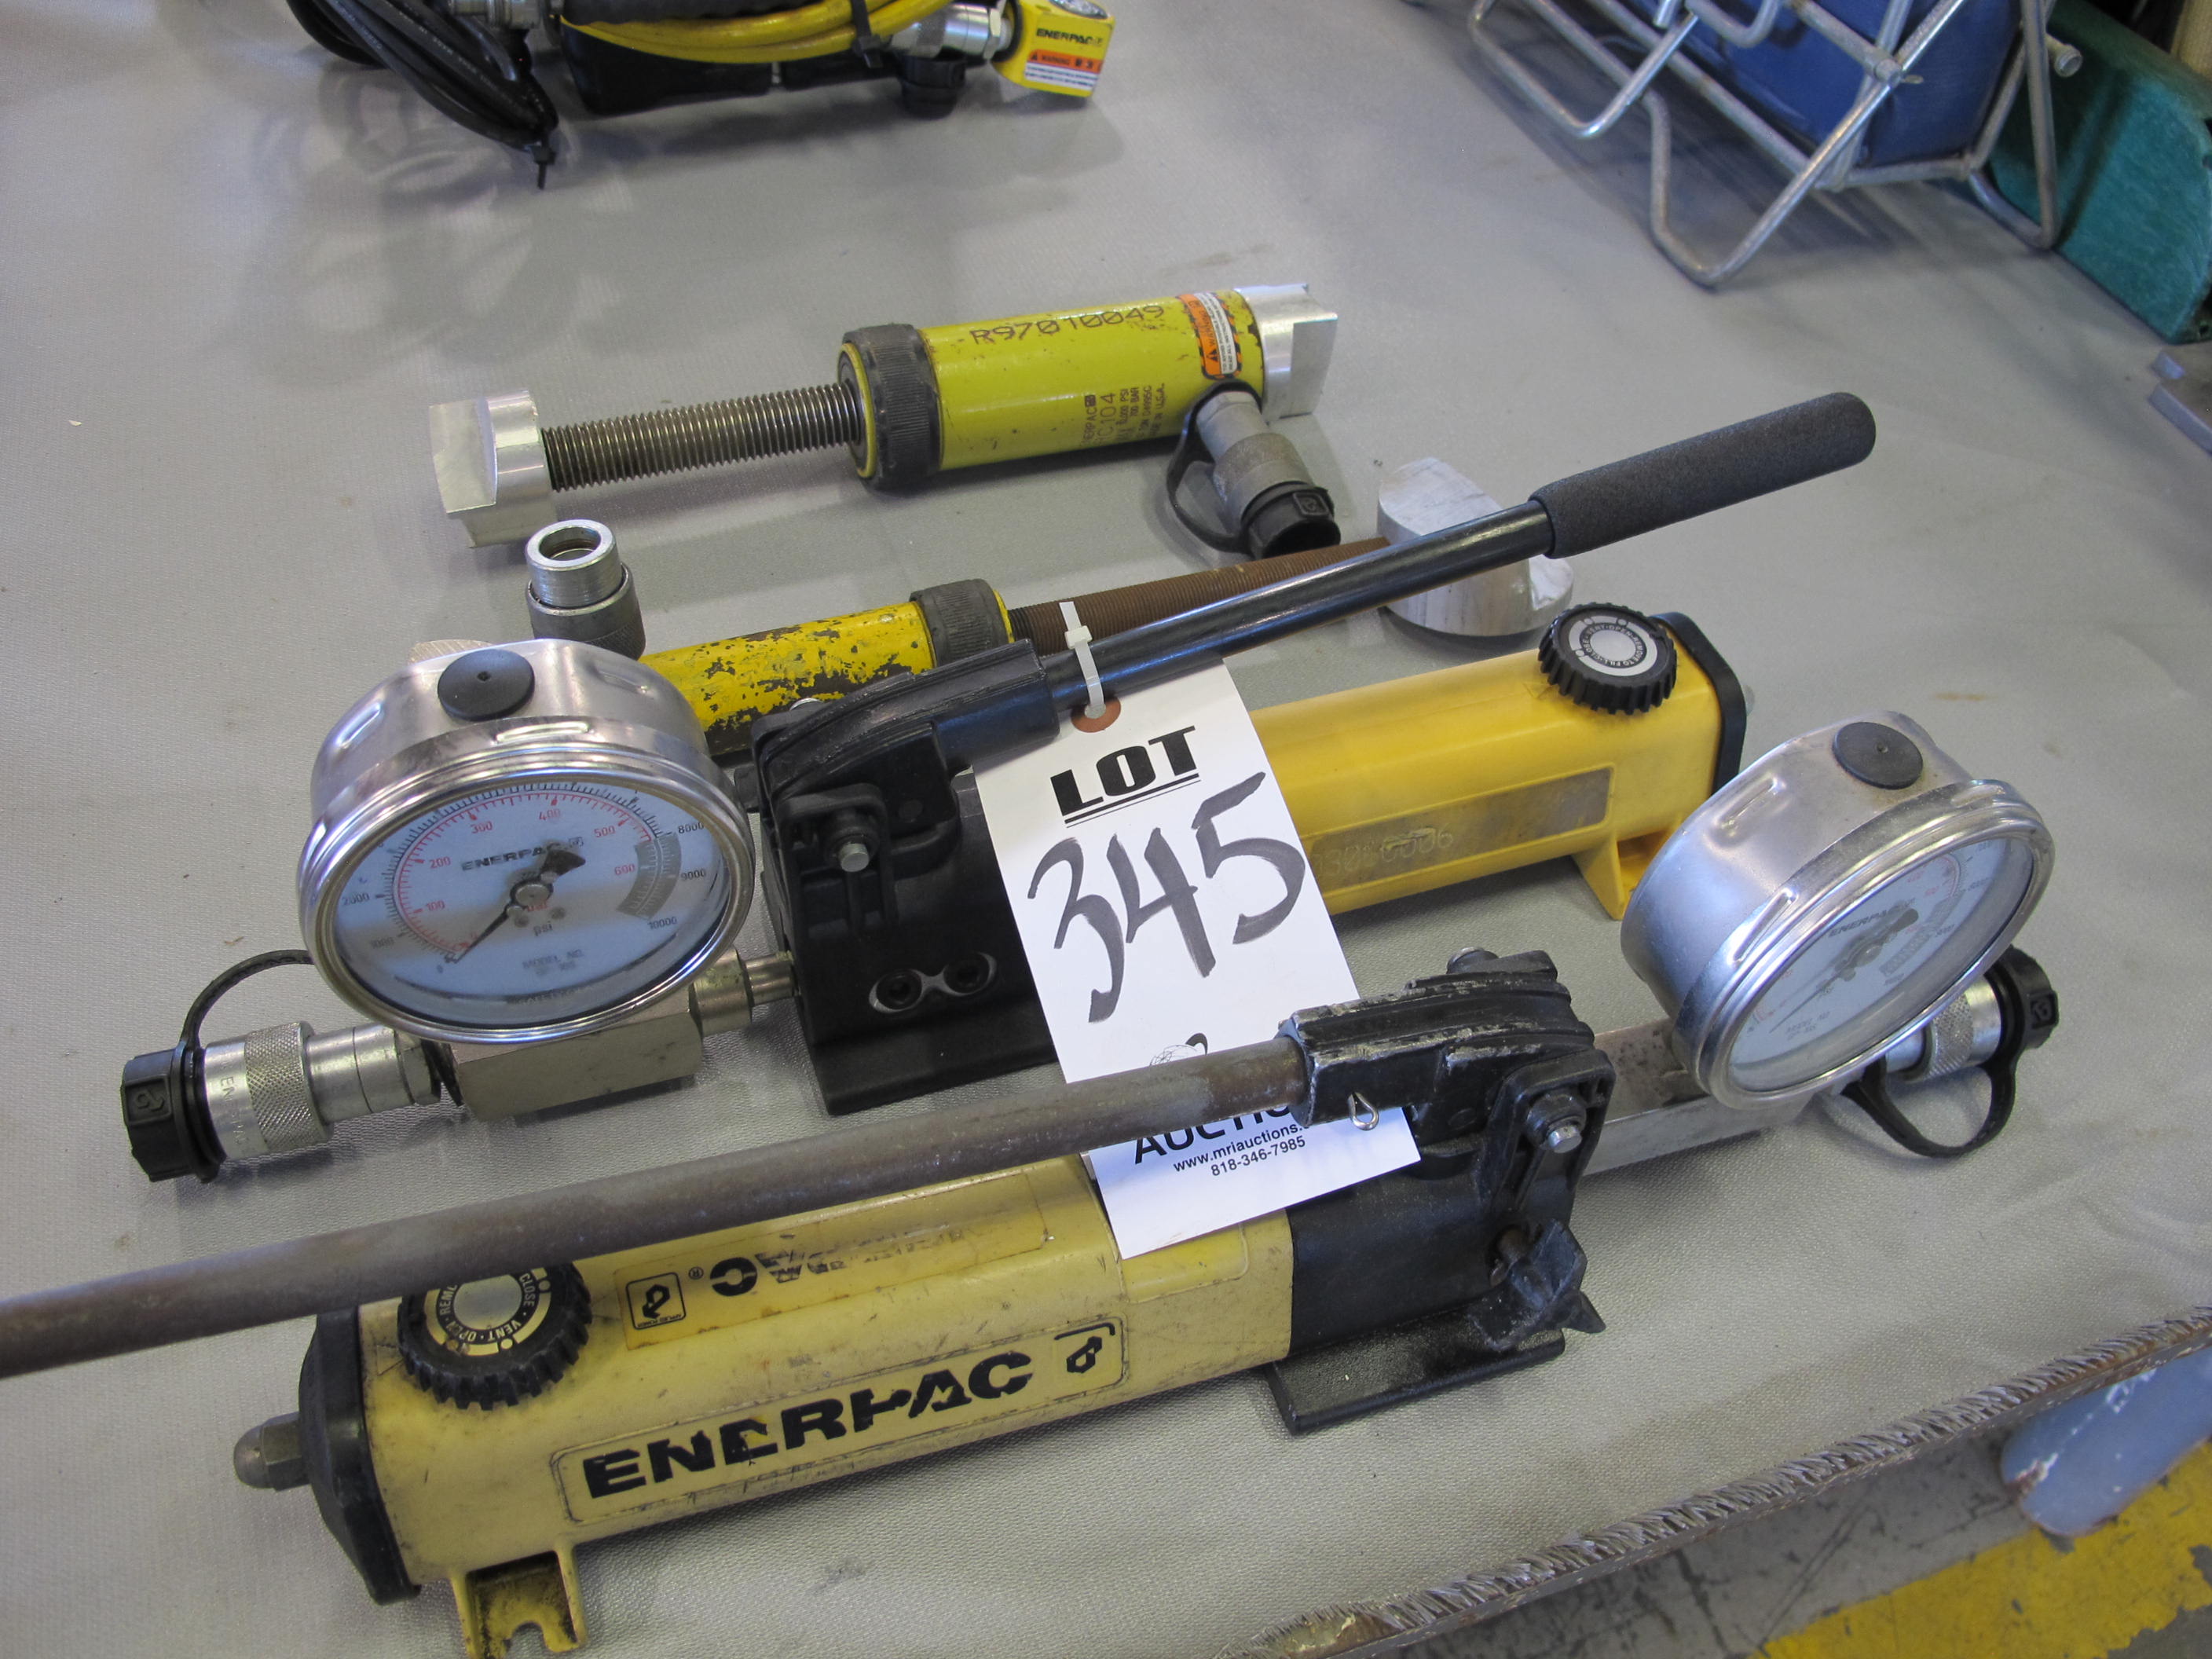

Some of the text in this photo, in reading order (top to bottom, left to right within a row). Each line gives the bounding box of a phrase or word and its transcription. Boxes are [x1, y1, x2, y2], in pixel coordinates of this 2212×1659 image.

[1036, 27, 1093, 45] ENERPAC
[970, 305, 1166, 345] R97010049
[1049, 724, 1200, 816] LOT
[539, 808, 561, 821] 400
[470, 821, 493, 834] 300
[594, 825, 616, 839] 500
[678, 822, 705, 834] 8000
[430, 856, 452, 869] 200
[614, 863, 635, 876] 600
[680, 868, 707, 881] 9000
[1027, 771, 1306, 1024] 345
[425, 899, 445, 912] 100
[1210, 1135, 1307, 1177] 818-346-7985
[518, 1273, 537, 1308] CLOSE
[486, 1319, 522, 1342] VENT
